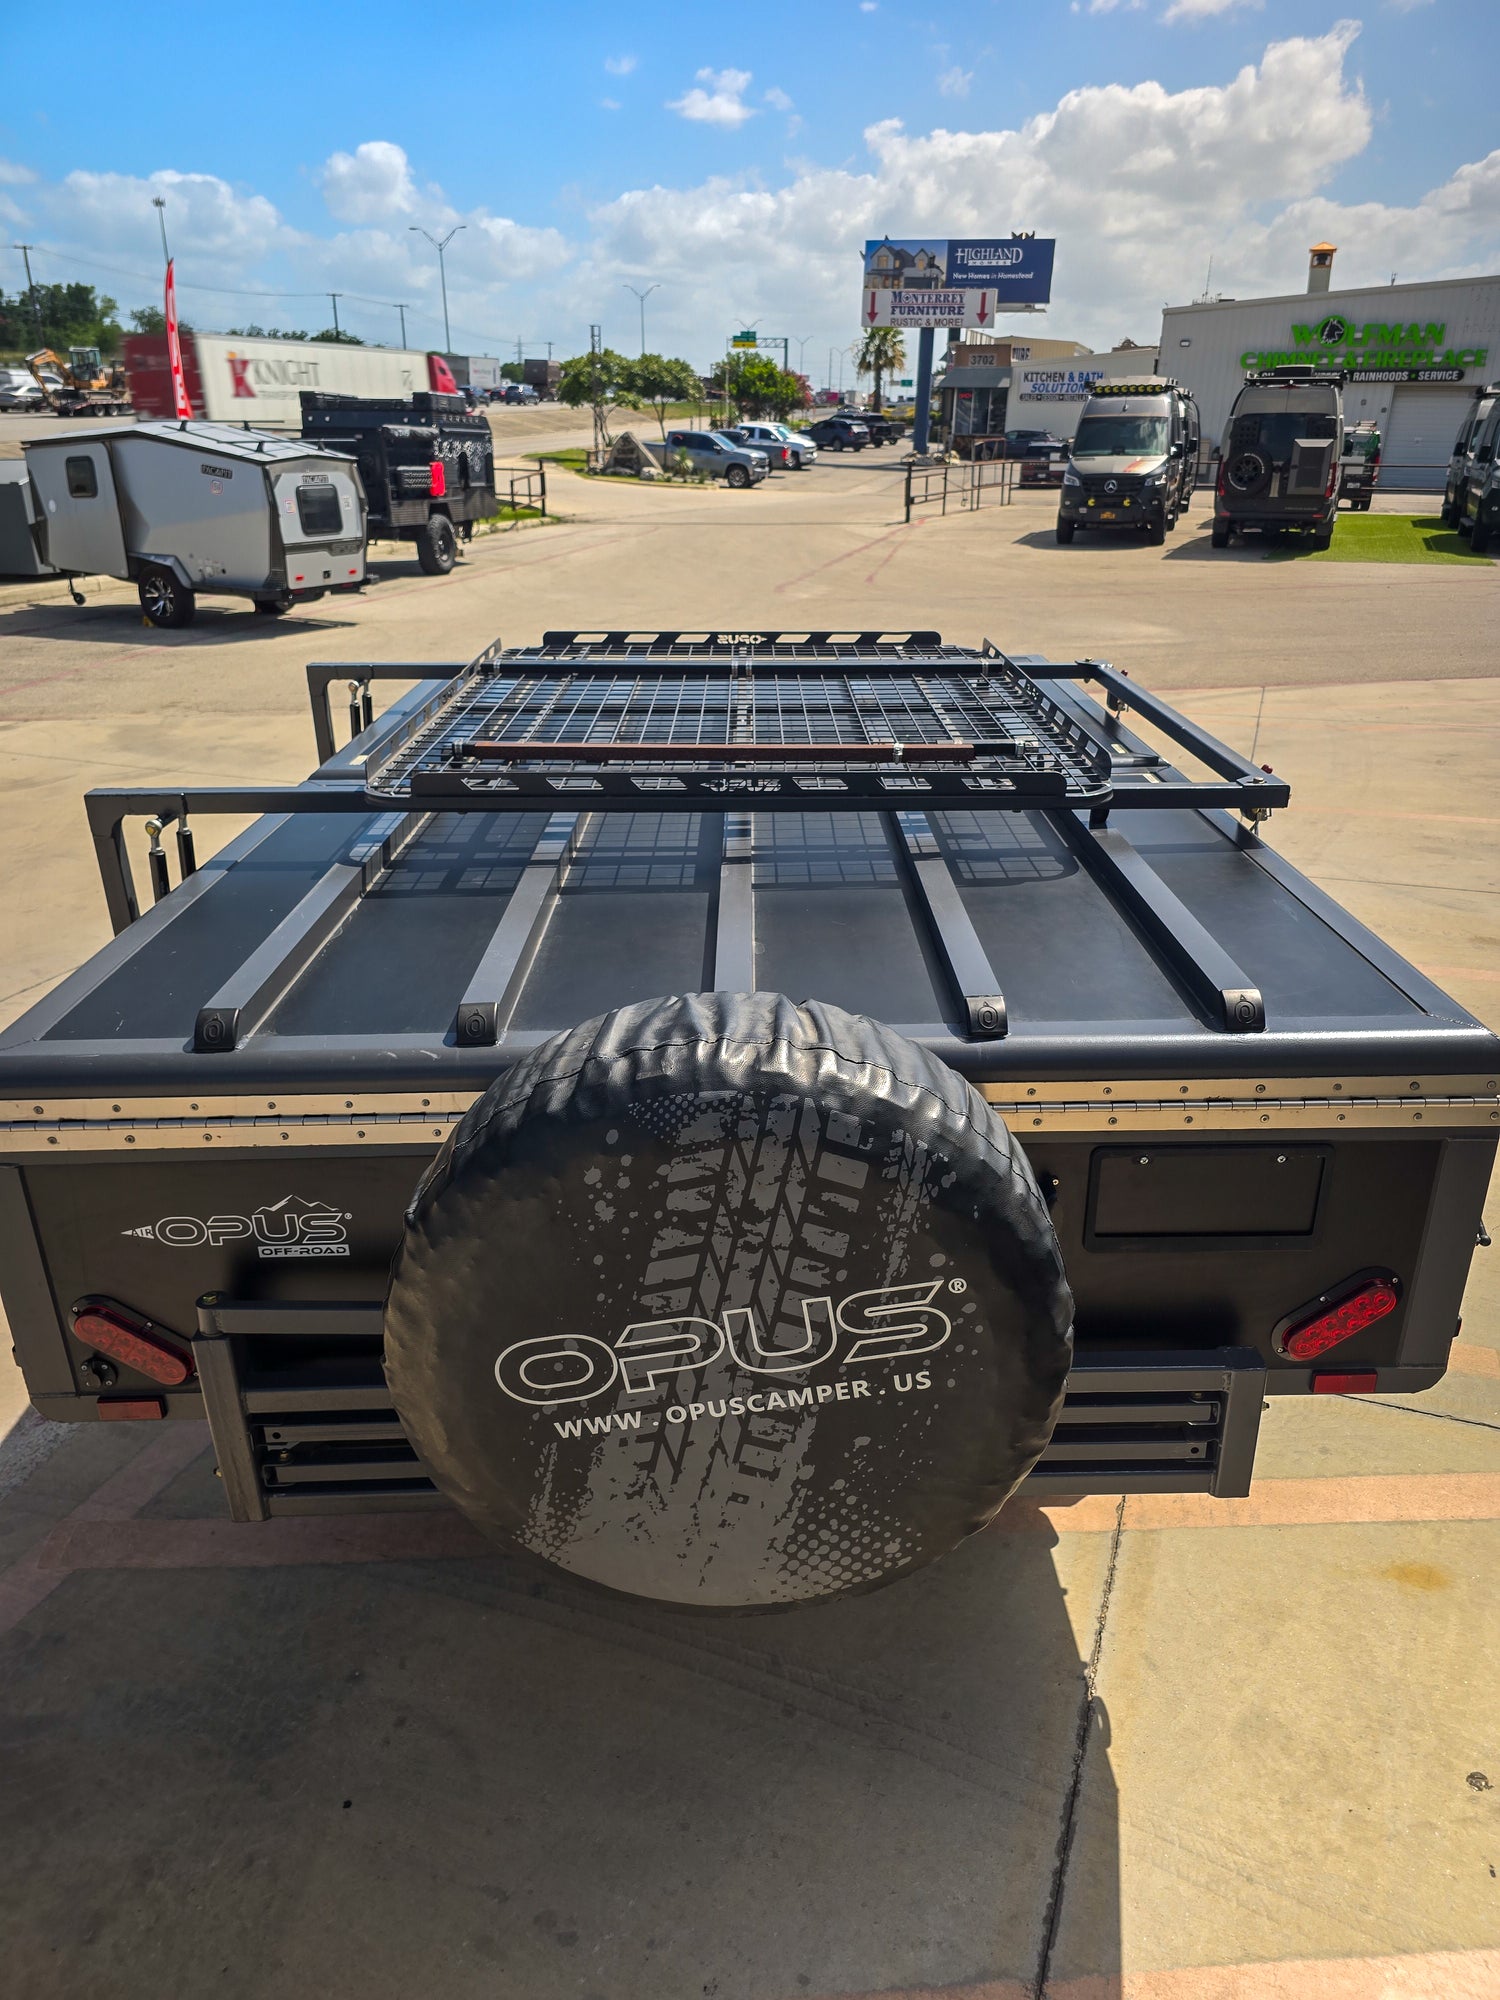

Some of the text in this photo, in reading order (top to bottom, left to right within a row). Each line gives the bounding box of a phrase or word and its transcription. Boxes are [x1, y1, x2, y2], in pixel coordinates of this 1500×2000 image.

[955, 247, 1023, 264] HIGHLAND
[891, 291, 966, 304] MONTERREY
[890, 306, 965, 315] FURNITURE
[890, 318, 964, 327] RUSTIC & MORE!
[1291, 315, 1446, 348] WOLFMAN
[970, 355, 995, 366] 3702
[1240, 349, 1489, 369] CHIMNEY & FIREPLACE
[1023, 372, 1104, 383] KITCHEN & BATH
[1353, 371, 1459, 381] RAINHOODS SERVICE
[260, 1246, 348, 1258] OFF-ROAD
